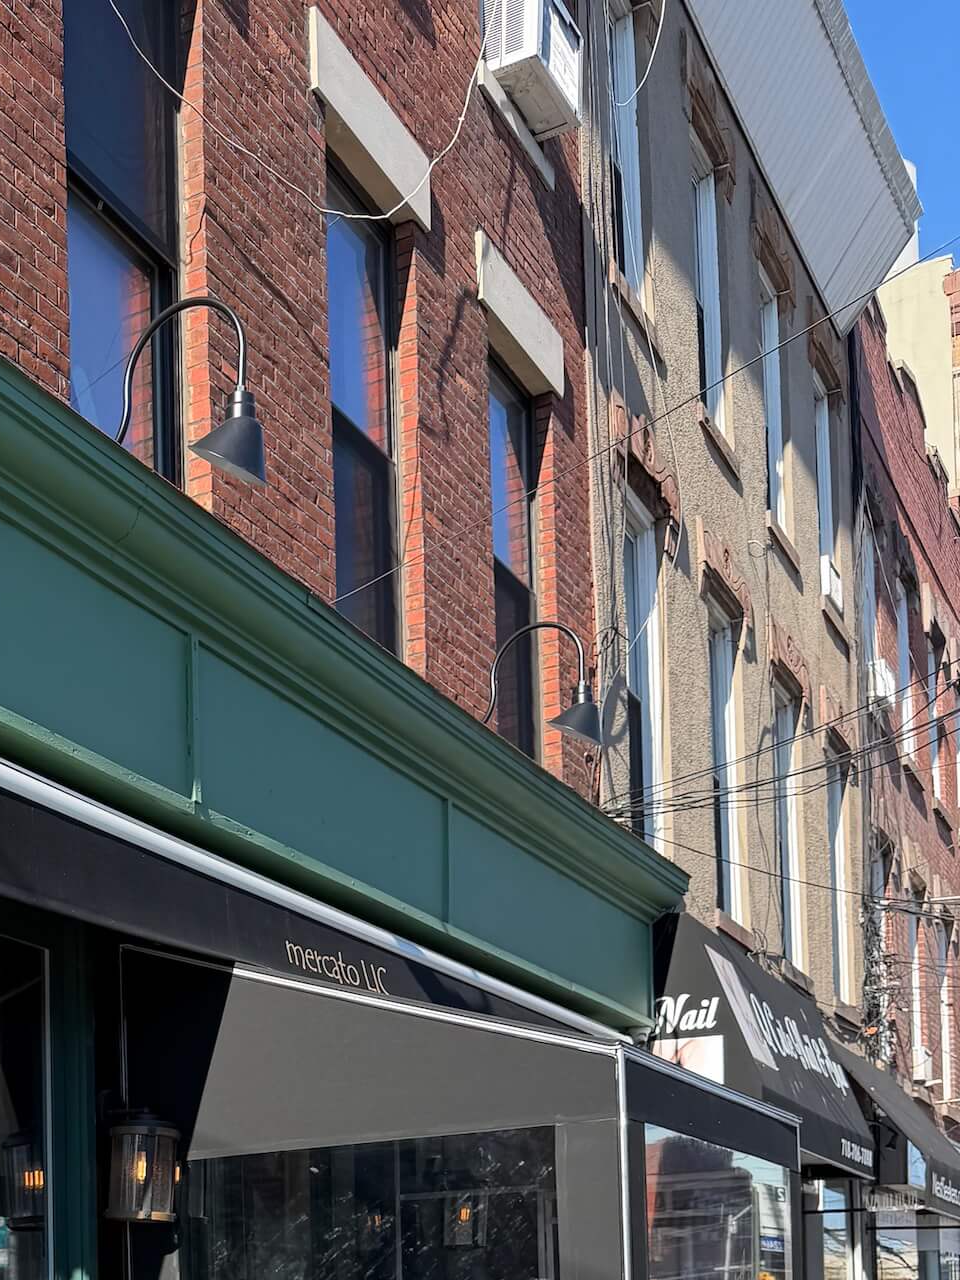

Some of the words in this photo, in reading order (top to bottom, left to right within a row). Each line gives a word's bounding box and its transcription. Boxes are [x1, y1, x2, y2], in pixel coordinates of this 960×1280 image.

[285, 940, 361, 986] mercato
[361, 959, 390, 996] LIC
[650, 993, 721, 1035] Nail
